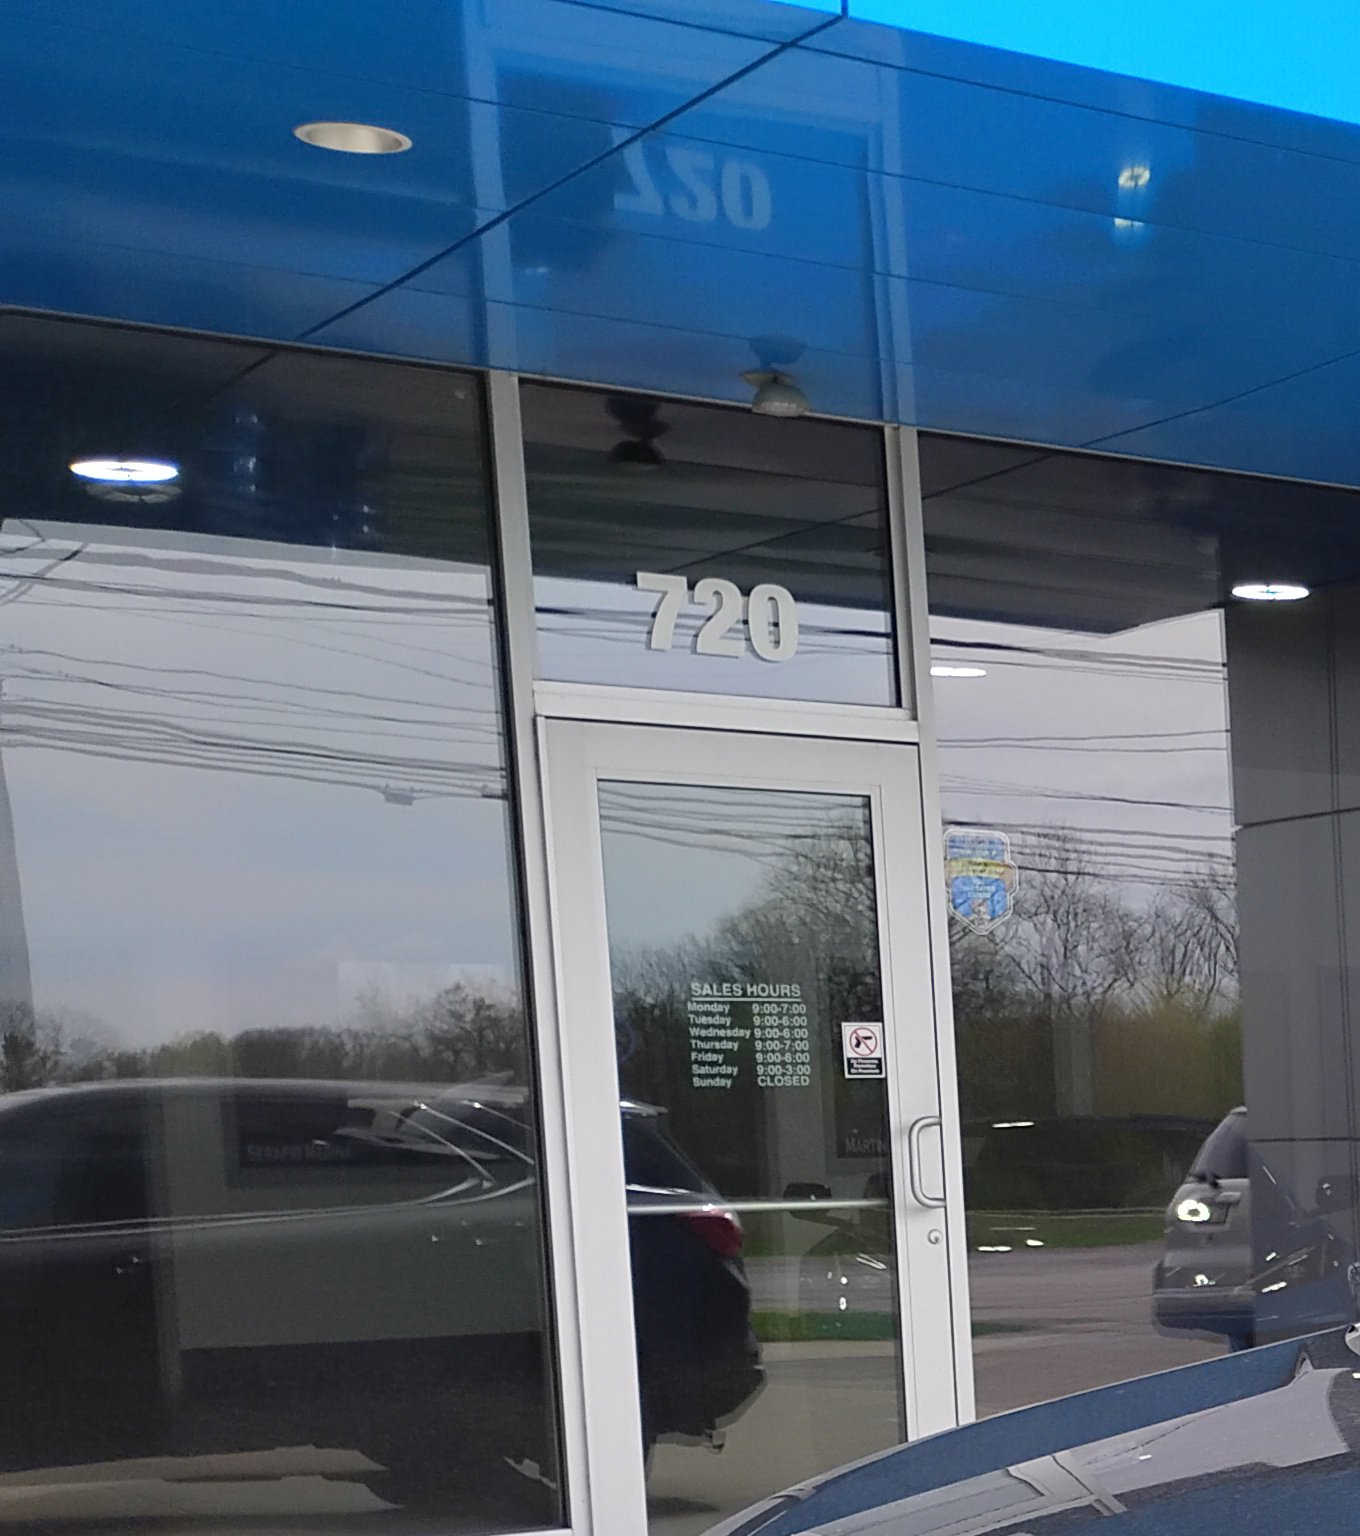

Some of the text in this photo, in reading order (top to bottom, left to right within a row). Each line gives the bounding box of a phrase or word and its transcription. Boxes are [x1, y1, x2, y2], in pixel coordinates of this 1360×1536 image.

[636, 571, 799, 662] 720
[690, 982, 801, 997] SALES HOURS
[687, 1001, 806, 1014] Monday 9:00-7:00
[688, 1014, 807, 1027] Tuesday 9:00-6:00
[689, 1027, 808, 1039] Wednesday 9:00-6:00
[690, 1039, 809, 1052] Thursday 9:00-7:00
[691, 1051, 810, 1064] Friday 9:00-6:00
[692, 1063, 811, 1076] Saturday 9:00-3:00
[693, 1076, 810, 1089] Sunday CLOSED
